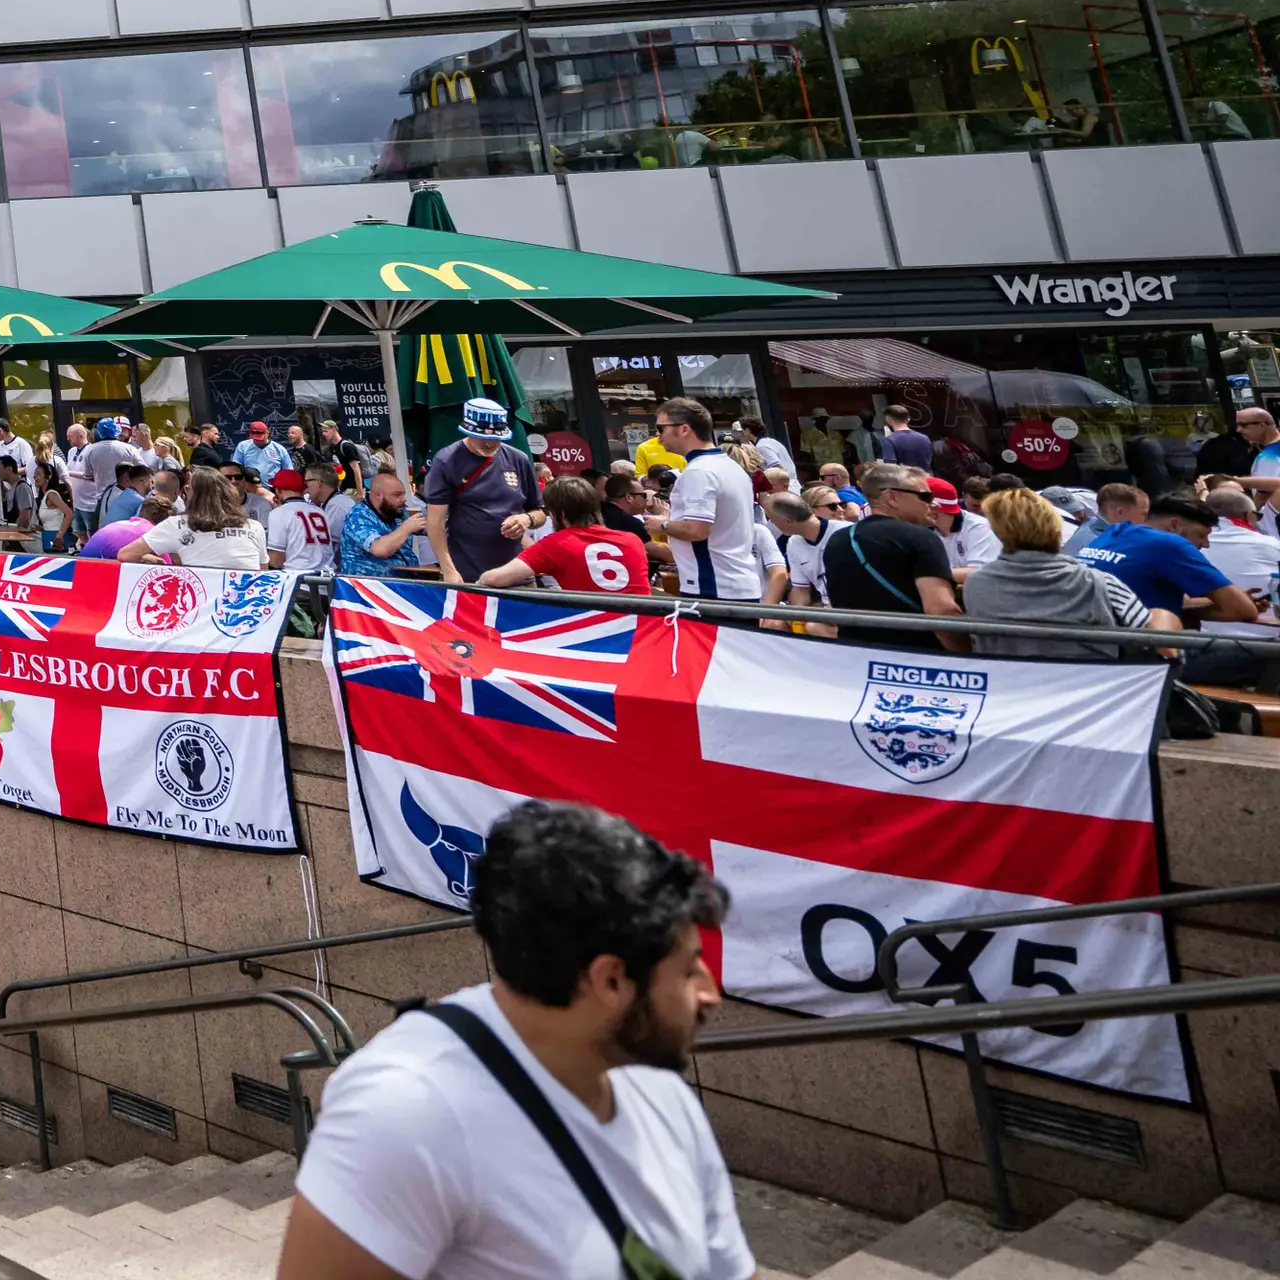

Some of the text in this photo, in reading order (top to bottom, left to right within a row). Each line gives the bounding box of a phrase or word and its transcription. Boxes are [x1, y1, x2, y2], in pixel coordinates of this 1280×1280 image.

[992, 271, 1178, 318] Wrangler
[340, 382, 377, 393] YOU'LL
[342, 395, 357, 405] SO
[344, 406, 389, 416] IN THESE
[347, 418, 380, 427] JEANS
[545, 448, 586, 463] -50%
[1016, 436, 1062, 453] -50%
[296, 510, 332, 546] 19
[584, 542, 631, 592] 6
[871, 664, 985, 690] ENGLAND
[160, 724, 226, 759] NORTHERN SOUL
[157, 768, 232, 809] MIDDLESBROUGH
[116, 805, 289, 843] Fly Me To The Moon
